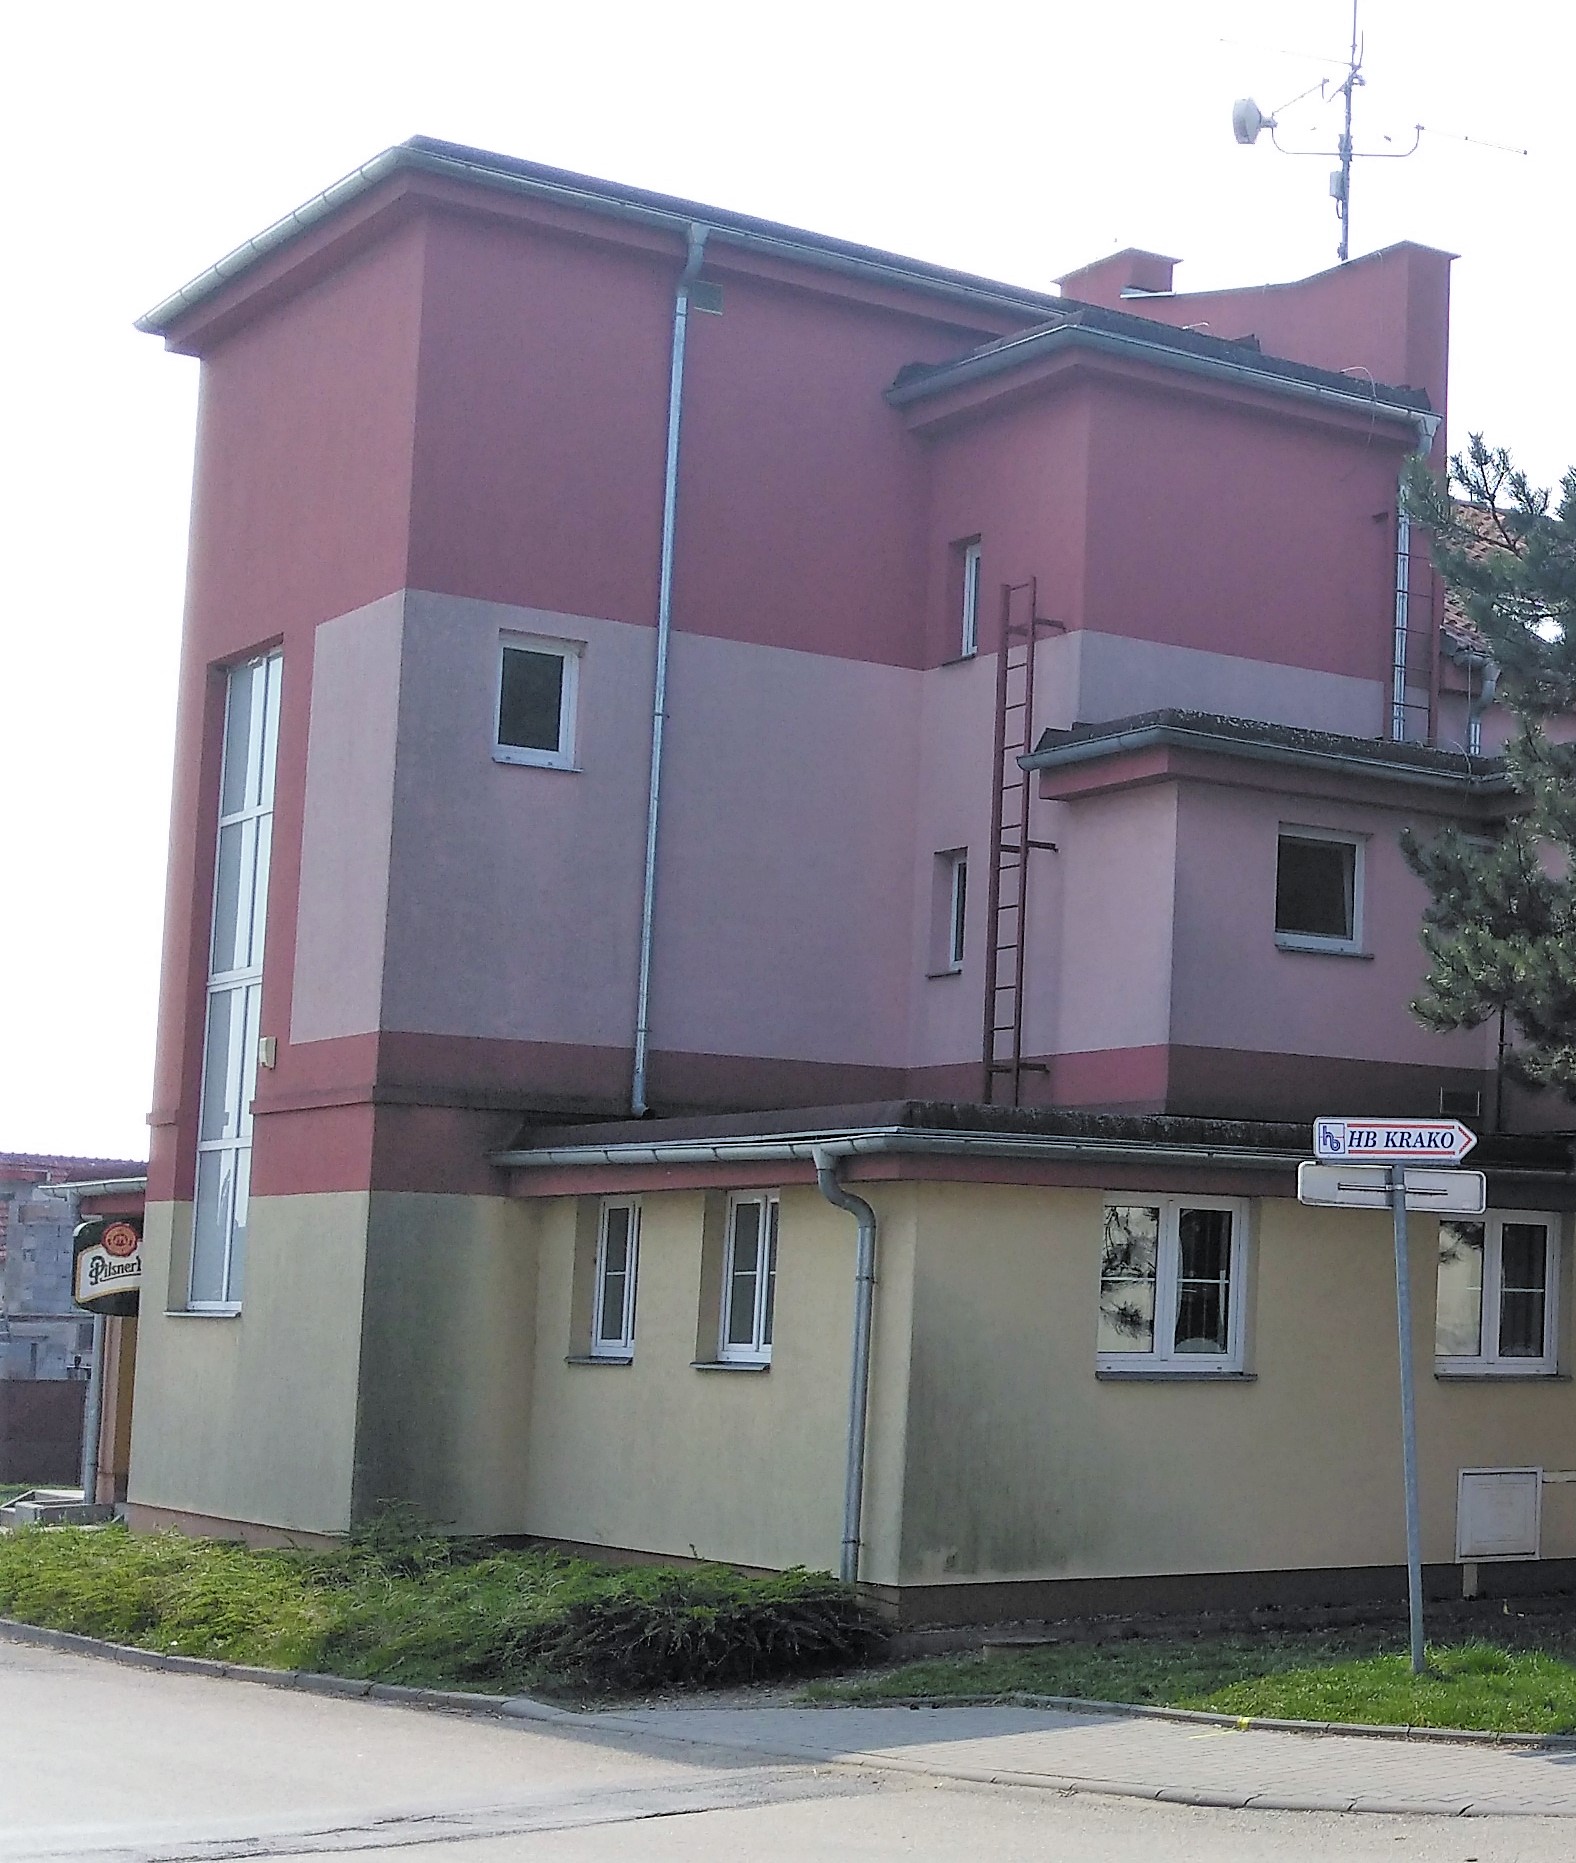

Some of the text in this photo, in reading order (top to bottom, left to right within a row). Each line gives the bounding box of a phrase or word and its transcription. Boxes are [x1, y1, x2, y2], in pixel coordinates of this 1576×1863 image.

[1348, 1131, 1454, 1148] HB KRAKO
[88, 1255, 137, 1286] Pilsner
